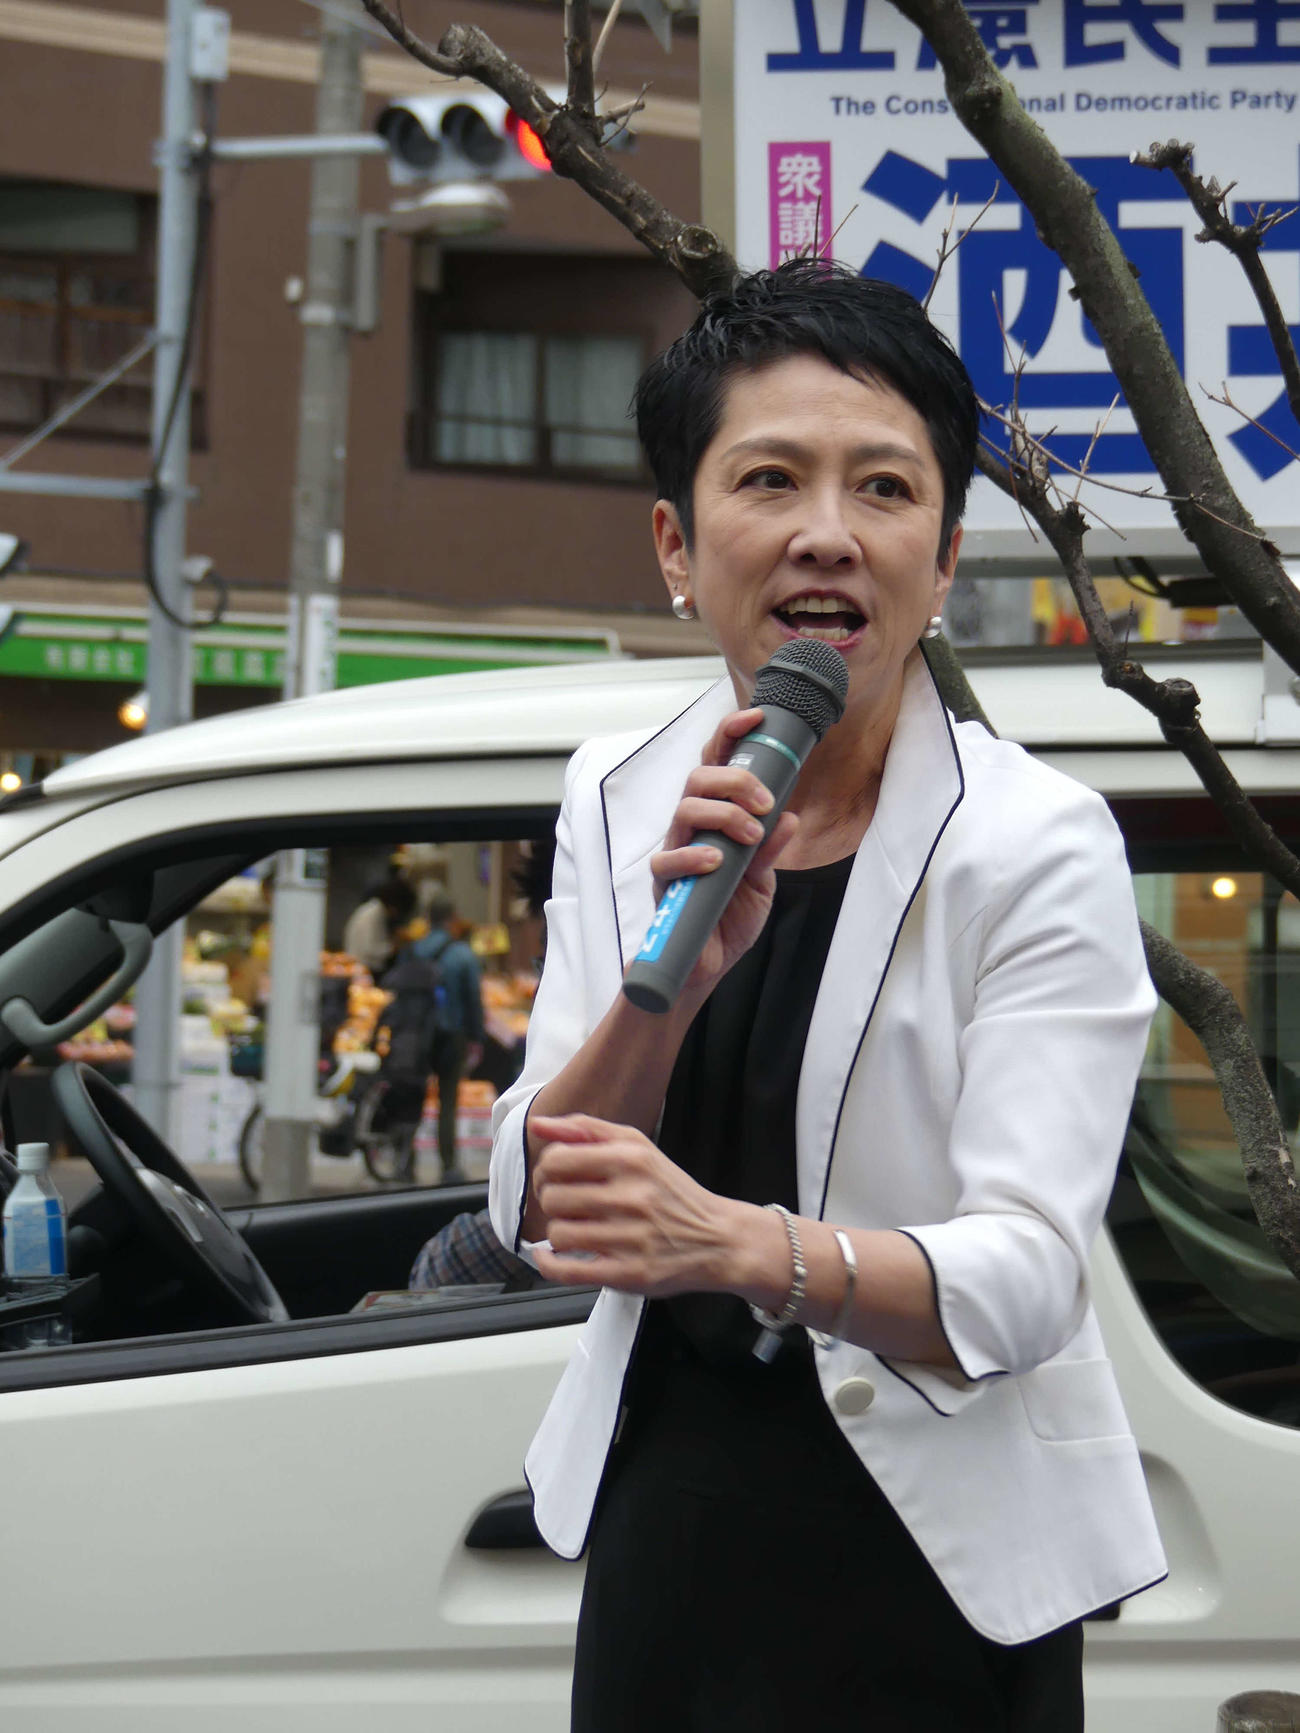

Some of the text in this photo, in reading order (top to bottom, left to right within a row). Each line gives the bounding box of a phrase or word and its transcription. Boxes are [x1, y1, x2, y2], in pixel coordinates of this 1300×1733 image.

[830, 89, 1297, 116] The Consnal Democratic Party
